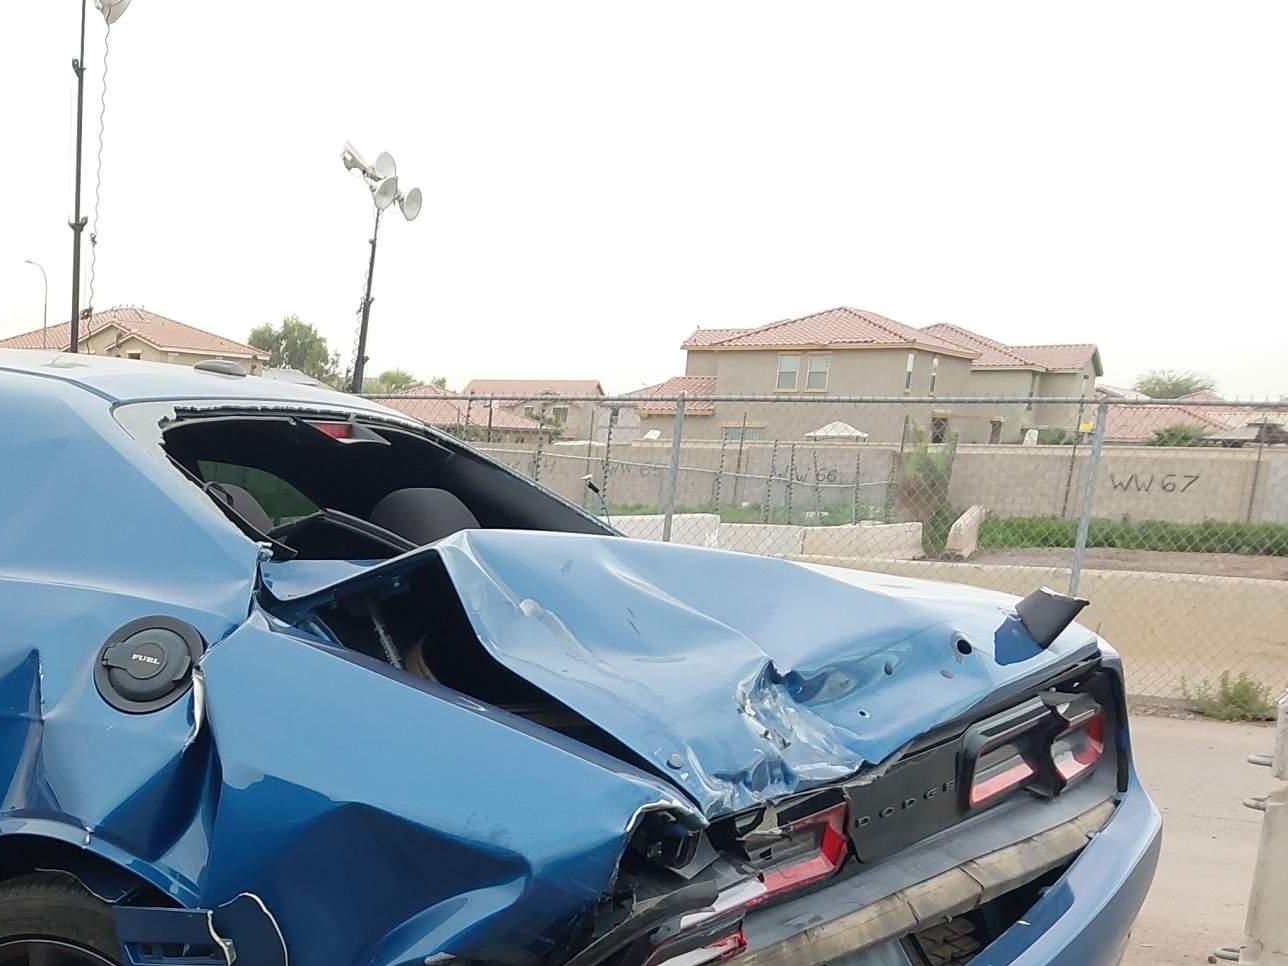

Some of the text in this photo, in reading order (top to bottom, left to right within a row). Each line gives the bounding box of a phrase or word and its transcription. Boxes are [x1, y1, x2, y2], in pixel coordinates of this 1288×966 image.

[815, 467, 838, 482] 66
[1109, 474, 1200, 493] WW 67
[132, 653, 160, 665] FUEL
